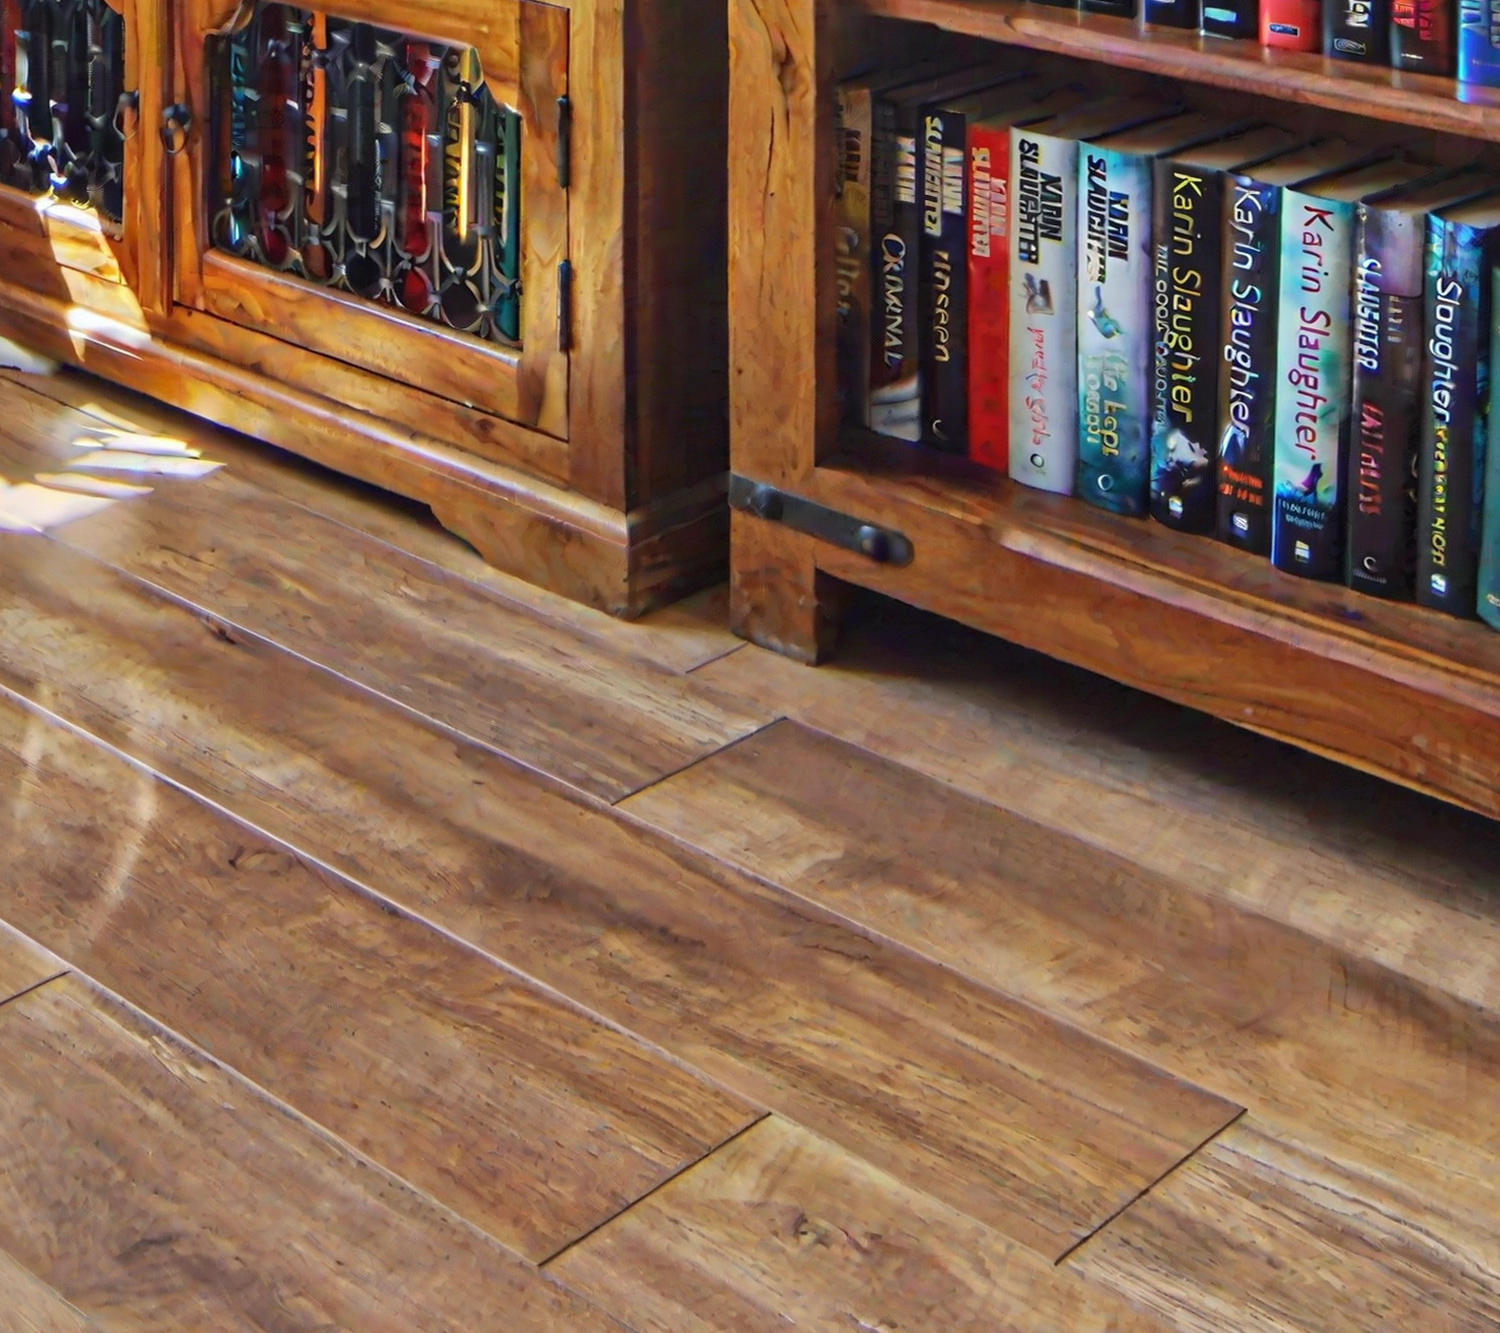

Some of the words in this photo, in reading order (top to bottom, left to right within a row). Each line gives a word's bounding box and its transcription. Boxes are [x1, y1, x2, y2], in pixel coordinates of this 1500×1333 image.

[1172, 171, 1202, 254] Karin
[1230, 186, 1261, 269] Karin
[1301, 206, 1334, 293] Karin
[1164, 267, 1200, 422] Slaughter
[1224, 280, 1260, 438] Slaughter
[1289, 307, 1331, 461] Slaughter
[1429, 277, 1462, 422] Slaughter
